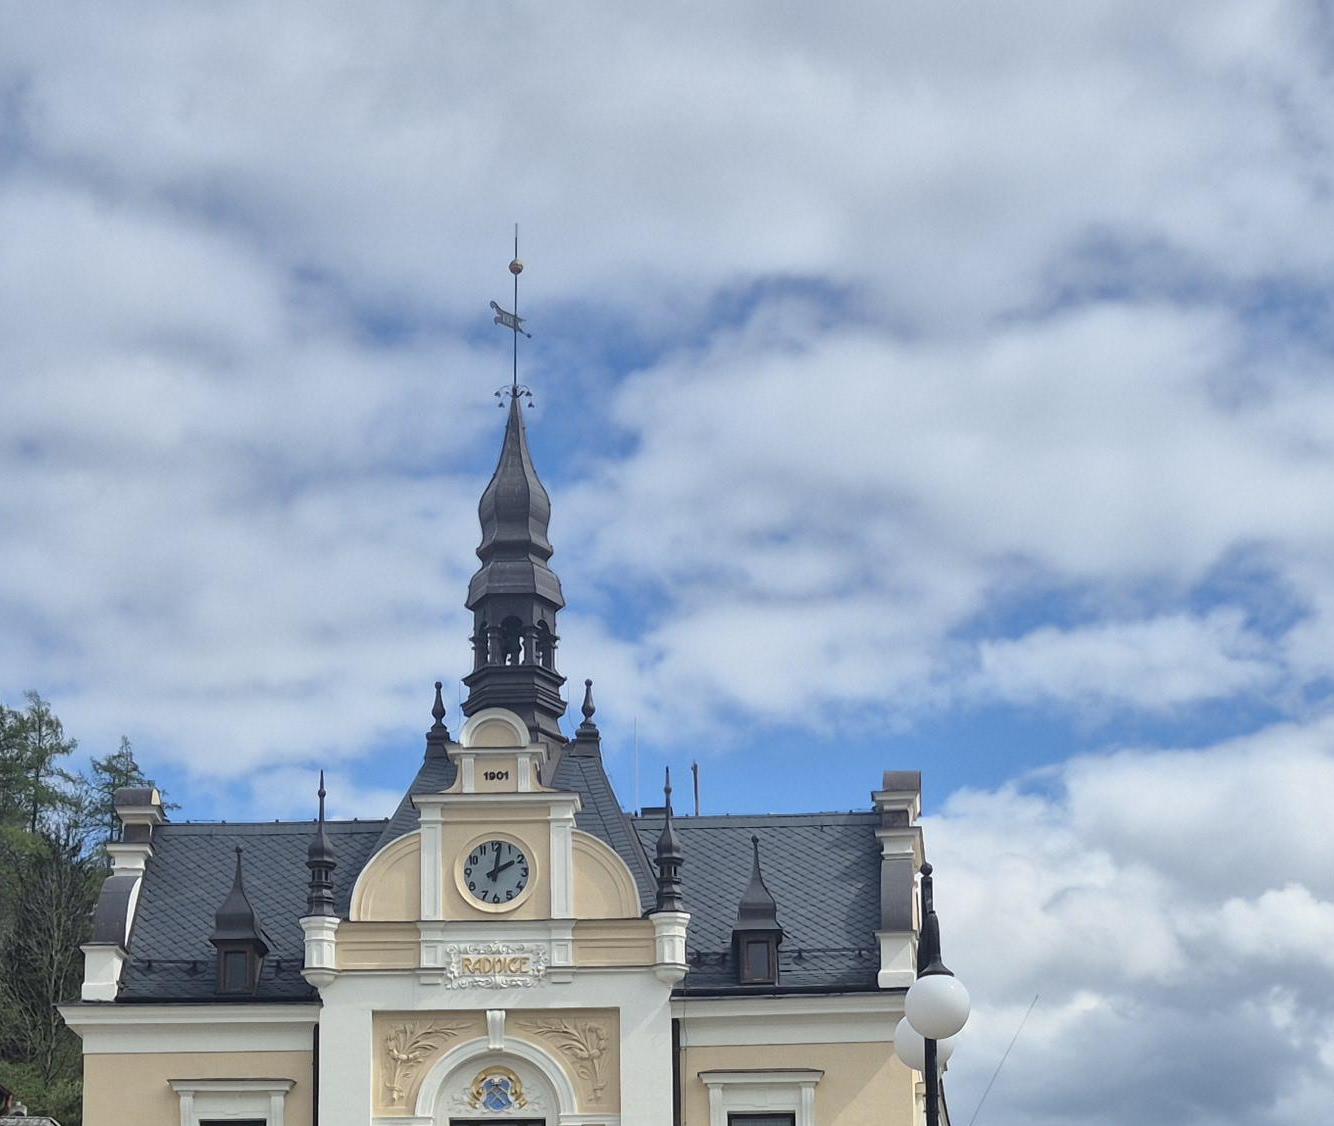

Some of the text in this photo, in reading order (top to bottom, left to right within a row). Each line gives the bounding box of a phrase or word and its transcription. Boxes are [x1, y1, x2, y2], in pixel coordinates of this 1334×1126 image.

[483, 771, 509, 781] 1901
[479, 845, 487, 856] 11
[508, 845, 512, 855] 1
[469, 854, 479, 866] 10
[516, 853, 525, 865] 2
[464, 867, 472, 878] 9
[520, 867, 529, 878] 3
[468, 881, 476, 892] 8
[516, 881, 524, 892] 4
[481, 890, 489, 901] 7
[492, 894, 500, 904] 6
[505, 890, 514, 901] 5
[461, 956, 530, 975] RADNICE
